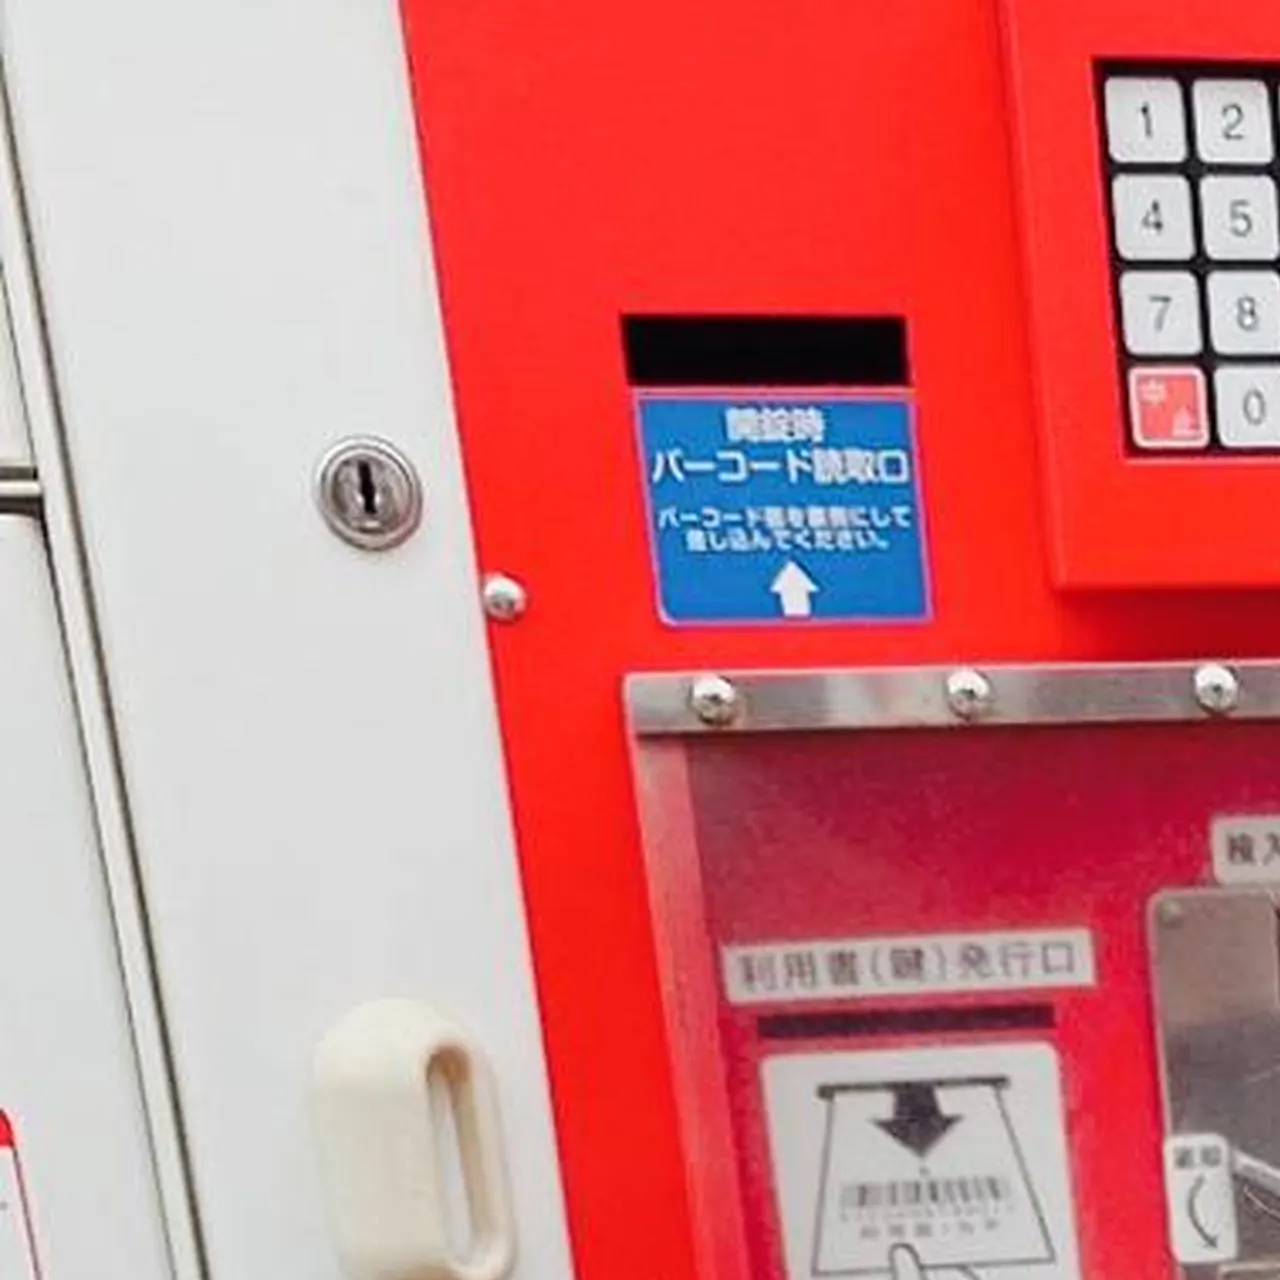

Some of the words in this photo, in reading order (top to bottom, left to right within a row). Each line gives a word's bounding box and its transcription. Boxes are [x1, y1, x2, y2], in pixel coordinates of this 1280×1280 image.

[1139, 105, 1154, 138] 1
[1222, 105, 1245, 140] 2
[1141, 201, 1163, 234] 4
[1231, 202, 1253, 237] 5
[1149, 298, 1171, 331] 7
[1238, 297, 1259, 331] 8
[1245, 391, 1266, 425] 0
